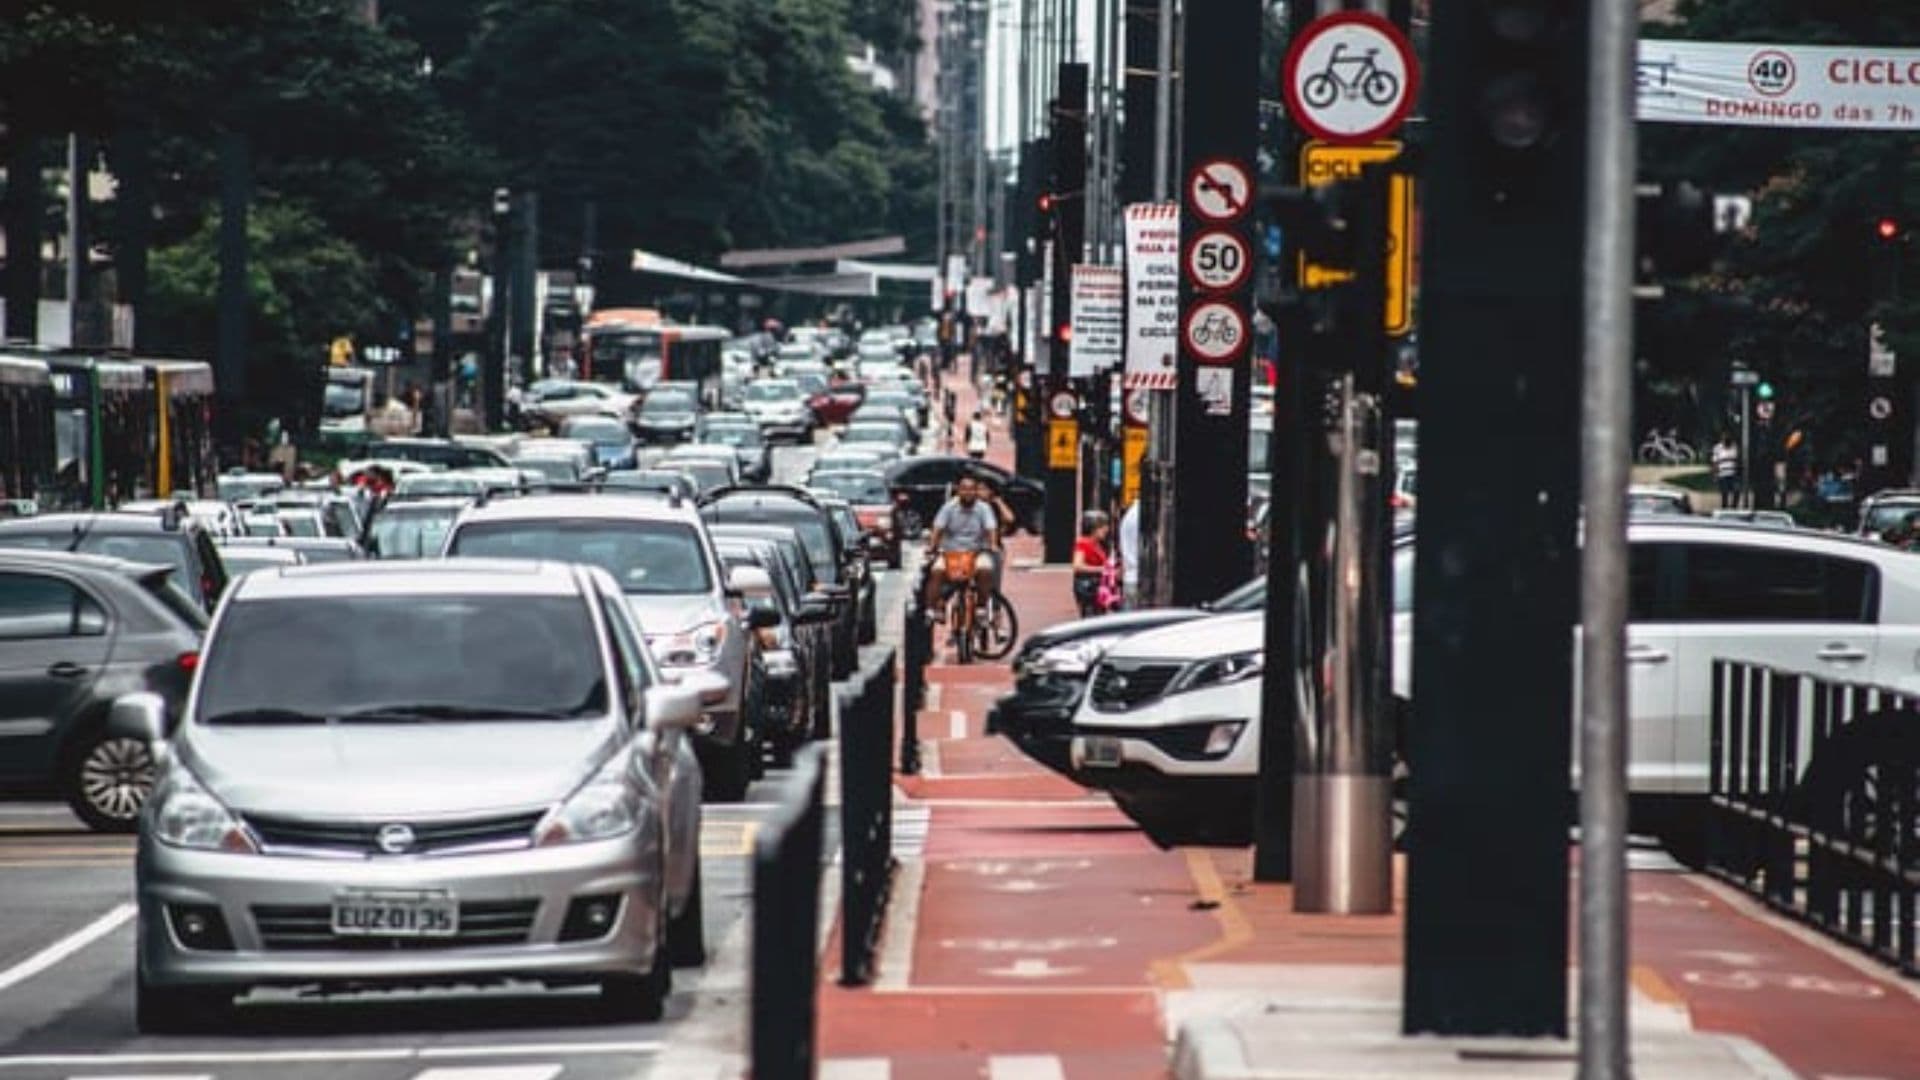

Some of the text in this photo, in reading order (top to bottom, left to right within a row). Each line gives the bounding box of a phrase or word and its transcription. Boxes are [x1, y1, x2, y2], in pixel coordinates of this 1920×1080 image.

[1755, 59, 1787, 78] 40
[1706, 98, 1914, 121] DOMINGO das 7h
[1198, 243, 1239, 271] 50
